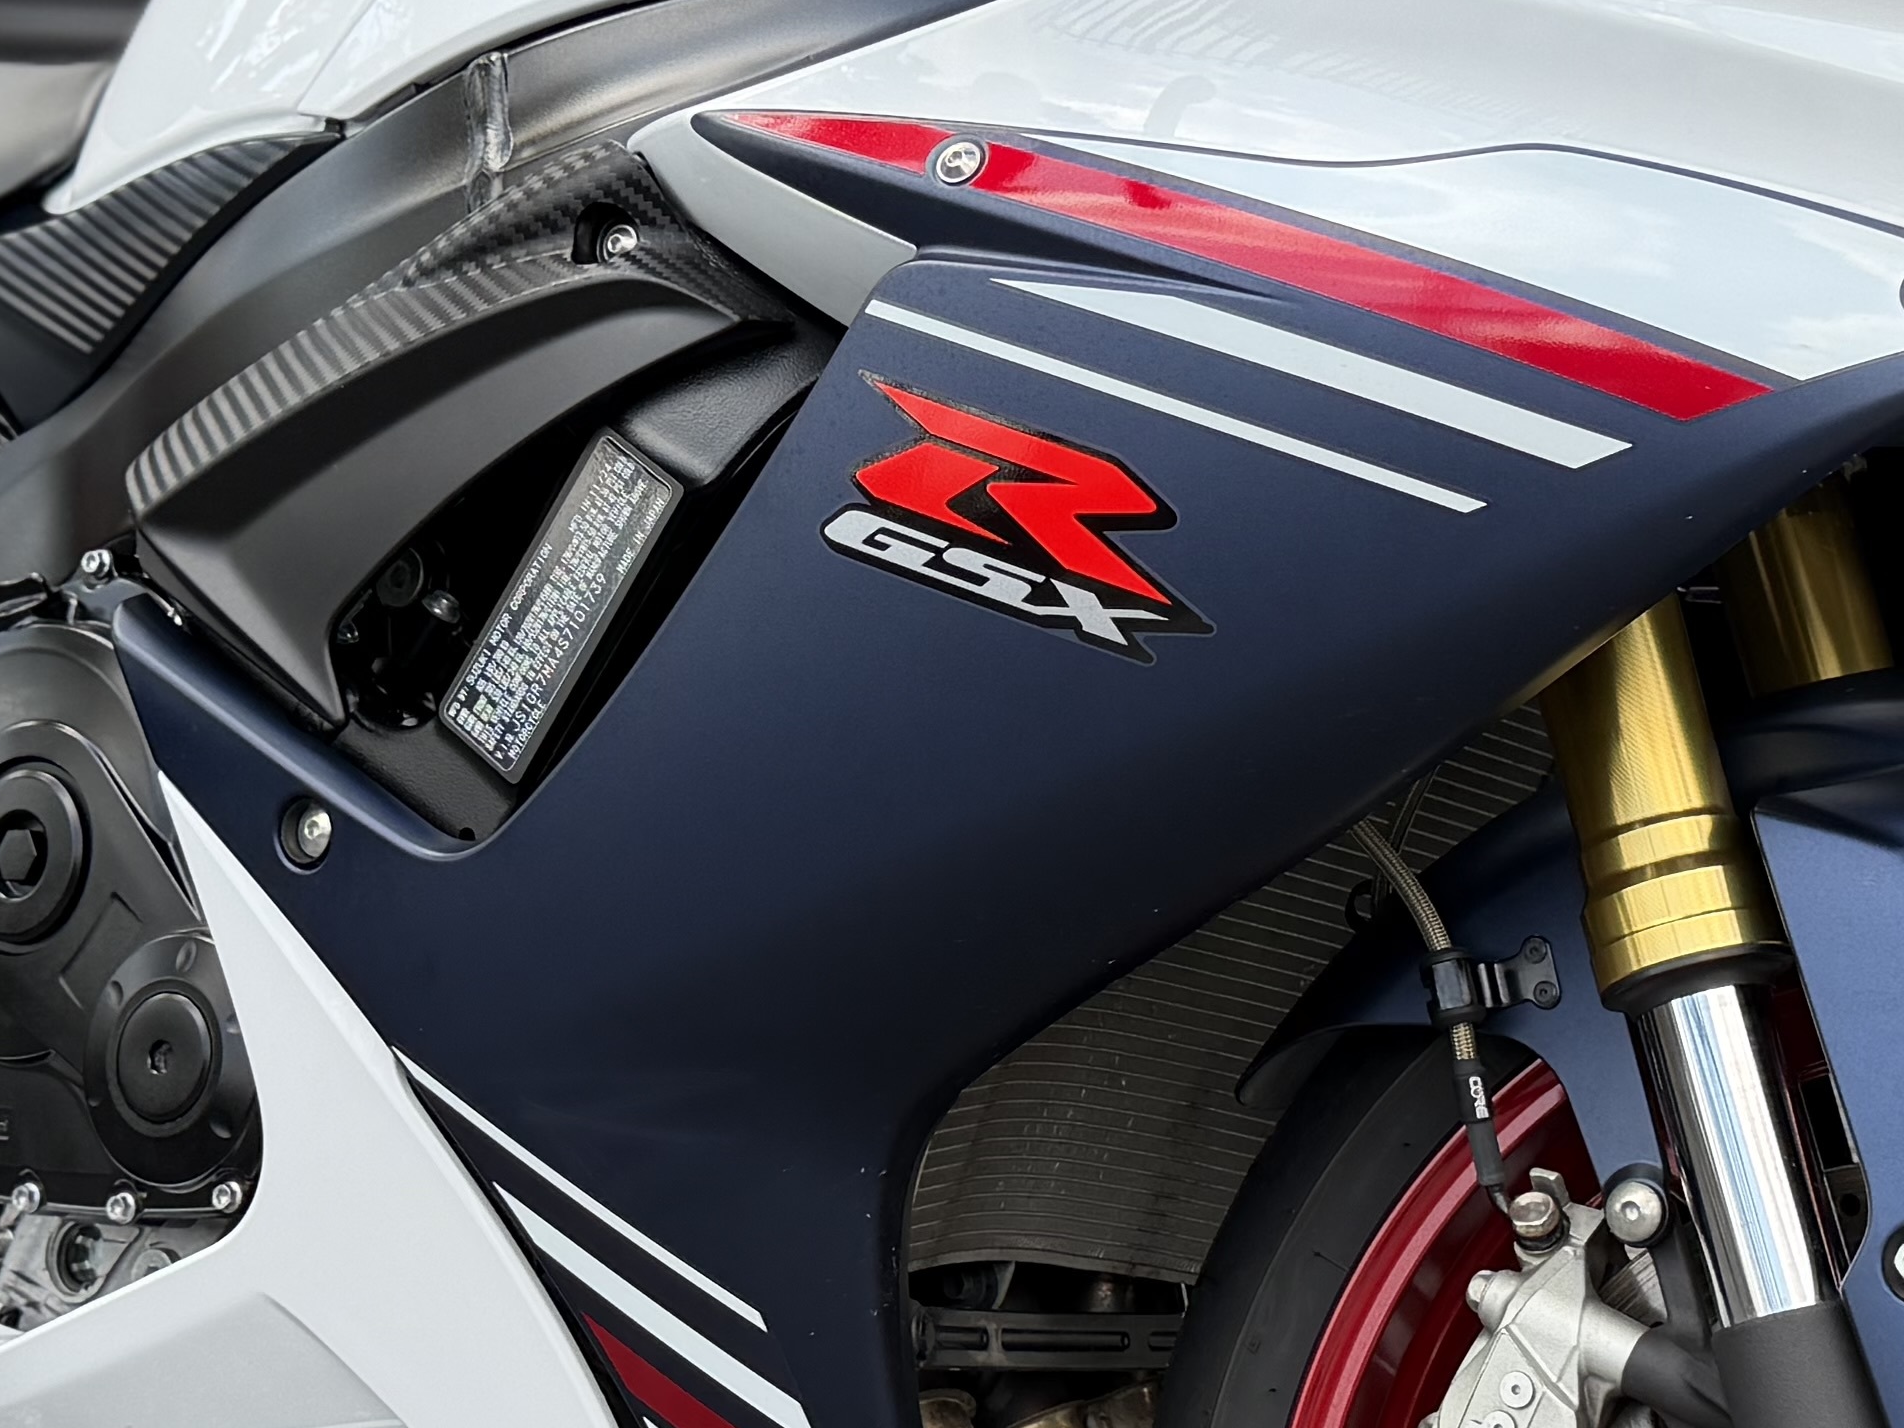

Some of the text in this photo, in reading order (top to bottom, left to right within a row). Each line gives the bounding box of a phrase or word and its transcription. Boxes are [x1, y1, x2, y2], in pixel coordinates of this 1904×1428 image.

[614, 546, 636, 575] MADE
[641, 495, 665, 529] JAPAN
[856, 380, 1173, 606] R
[464, 646, 492, 687] SUZUKI
[487, 611, 513, 647] MOTOR
[507, 541, 554, 612] CORPORATION
[823, 510, 1170, 646] GSX
[507, 698, 547, 760] MOTORCYCLE
[1469, 1076, 1489, 1119] CORE
